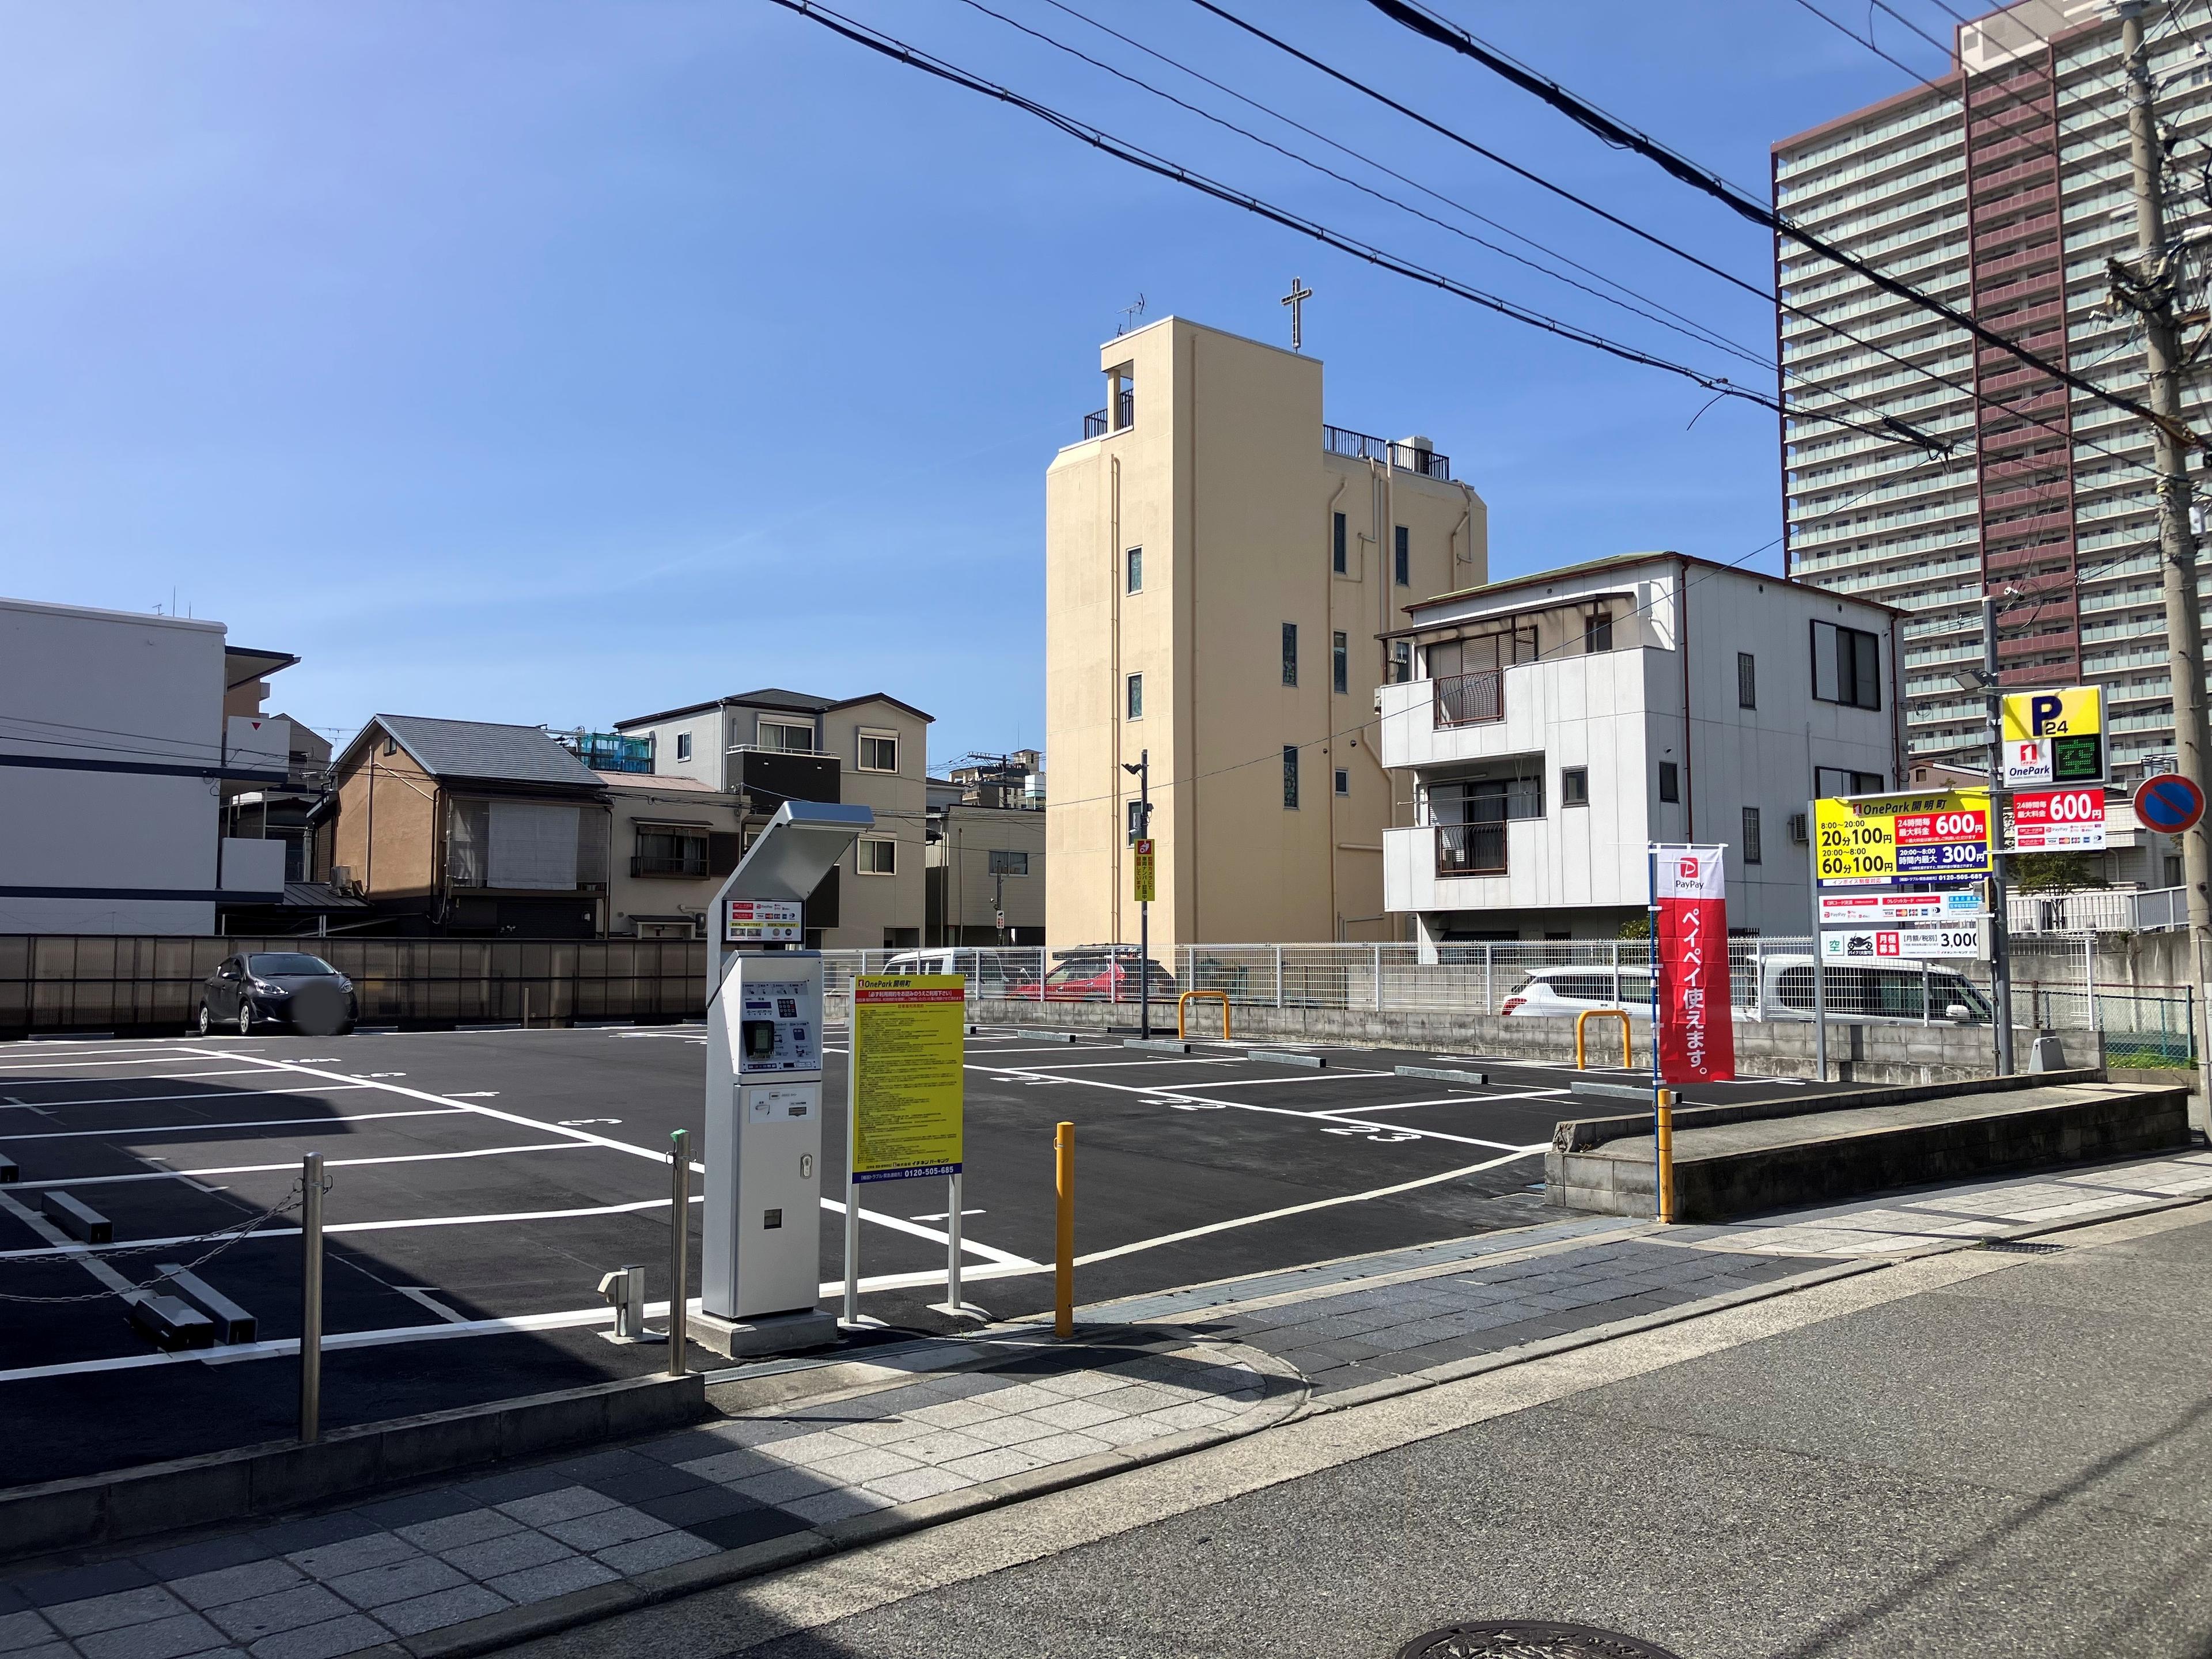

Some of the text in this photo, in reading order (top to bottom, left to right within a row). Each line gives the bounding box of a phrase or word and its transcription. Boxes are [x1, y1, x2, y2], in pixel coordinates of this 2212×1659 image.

[2032, 696, 2062, 736] P
[2046, 721, 2069, 735] 24
[2058, 739, 2096, 775] 空
[2009, 765, 2051, 776] OnePark
[1863, 801, 1910, 815] OnePark
[1911, 799, 1947, 812] 開明町
[2016, 801, 2047, 809] 24時間毎
[2050, 793, 2103, 821] 600円
[2017, 810, 2047, 819] 最大料金
[1897, 817, 1931, 827] 24時間毎
[1936, 814, 1983, 835] 600円
[1899, 827, 1930, 837] 最大料金
[1899, 855, 1938, 865] 時間内最大
[1942, 845, 1985, 863] 300円
[1676, 880, 1704, 891] PayPay
[1829, 940, 1840, 952] 空
[1682, 908, 1707, 1075] ペイペイ使えます。
[1137, 1098, 1226, 1111] 22
[1319, 1126, 1422, 1142] 23
[904, 1166, 954, 1177] 0120-505-685
